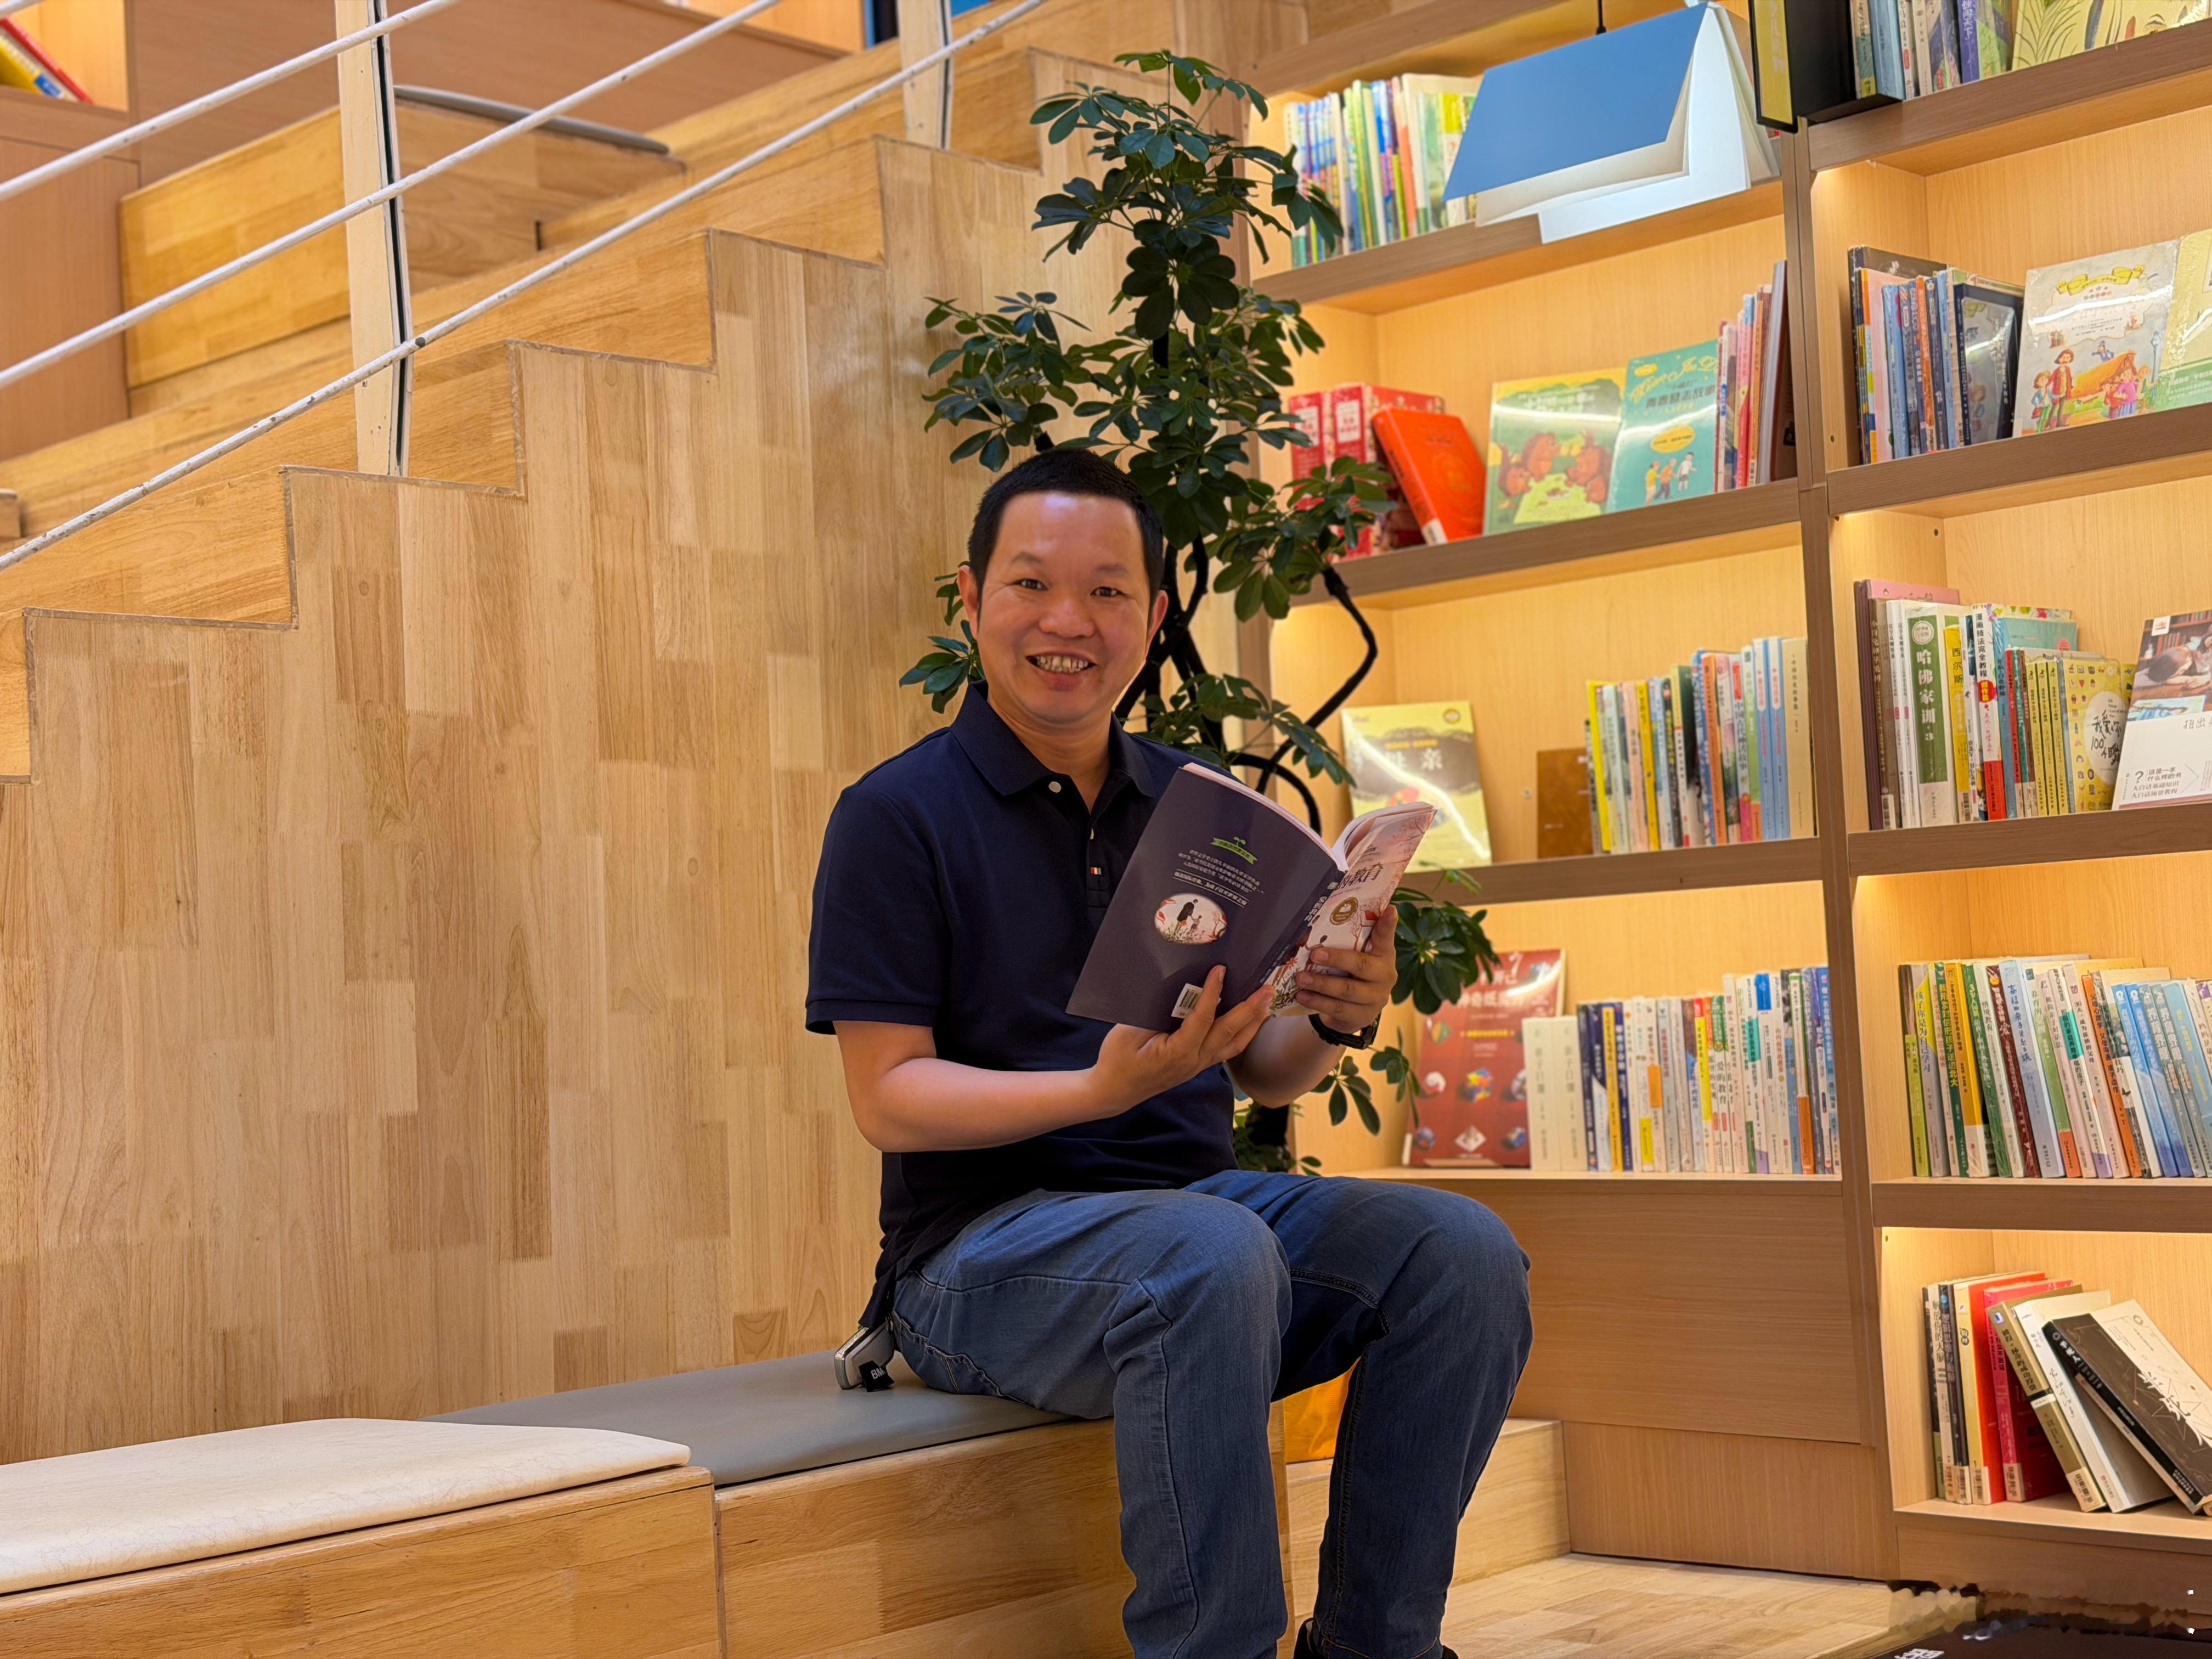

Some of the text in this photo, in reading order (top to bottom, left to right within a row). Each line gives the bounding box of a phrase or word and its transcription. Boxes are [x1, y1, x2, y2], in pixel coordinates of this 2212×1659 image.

[1976, 613, 1987, 677] 漫画技法完全教程
